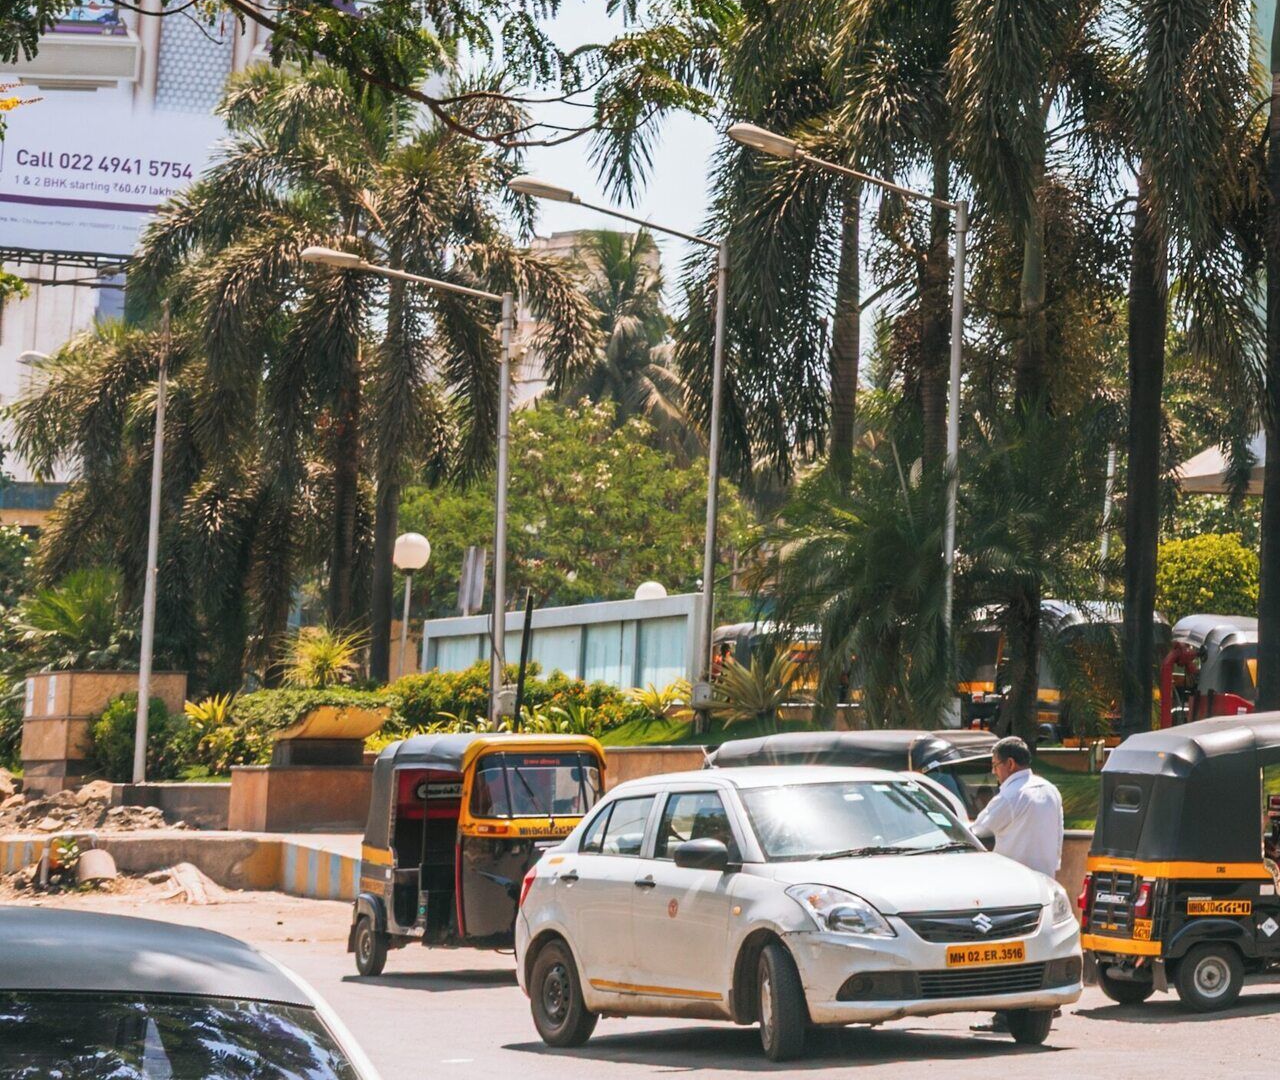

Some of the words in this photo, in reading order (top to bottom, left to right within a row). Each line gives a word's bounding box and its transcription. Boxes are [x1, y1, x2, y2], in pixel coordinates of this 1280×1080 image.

[17, 149, 54, 168] Call
[60, 153, 93, 171] 022
[98, 156, 142, 175] 4941
[149, 160, 193, 180] 5754
[23, 176, 31, 186] &
[34, 176, 41, 186] 2
[44, 177, 68, 189] BHK
[69, 181, 110, 194] starting
[113, 182, 147, 195] ₹60.67
